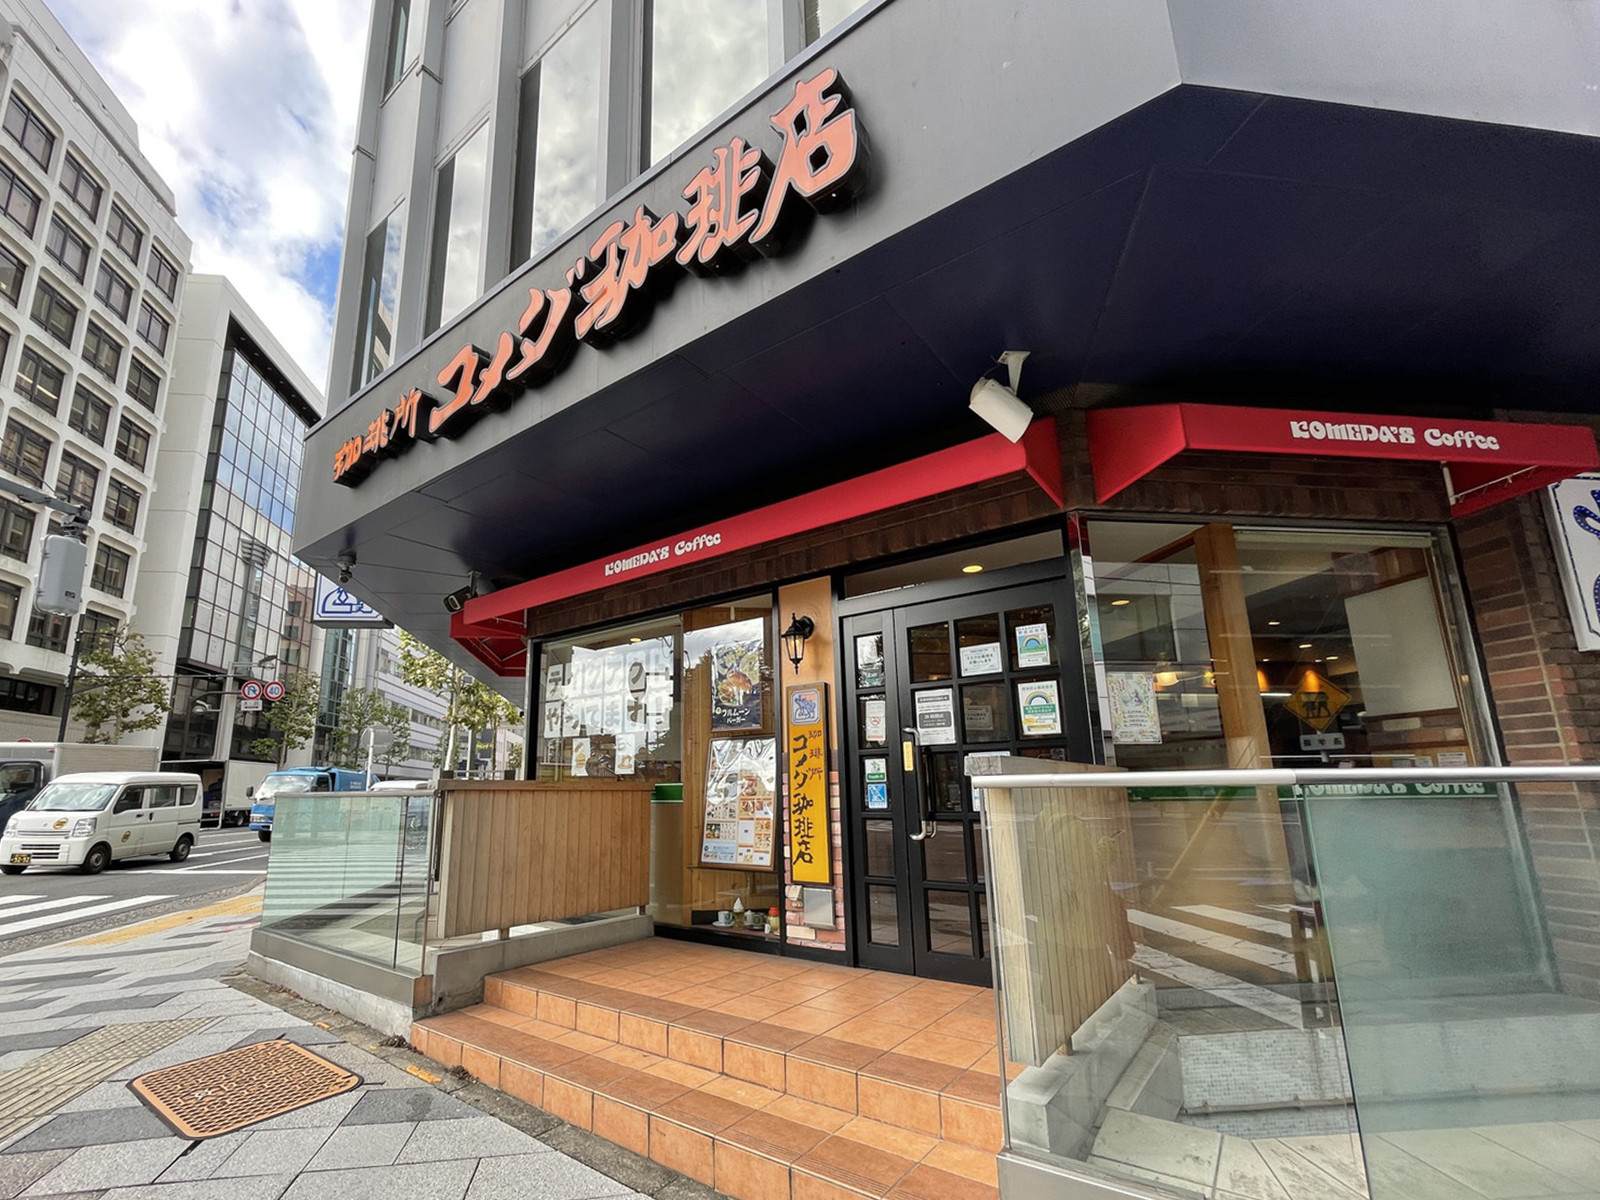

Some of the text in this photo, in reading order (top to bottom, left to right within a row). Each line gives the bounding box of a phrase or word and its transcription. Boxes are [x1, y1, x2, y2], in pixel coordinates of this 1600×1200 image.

[428, 67, 858, 433] コメダ珈琲店
[1290, 420, 1500, 450] KOMEDA'S Coffee
[605, 533, 721, 576] KOMEDA'S Coffee
[268, 686, 280, 695] 40
